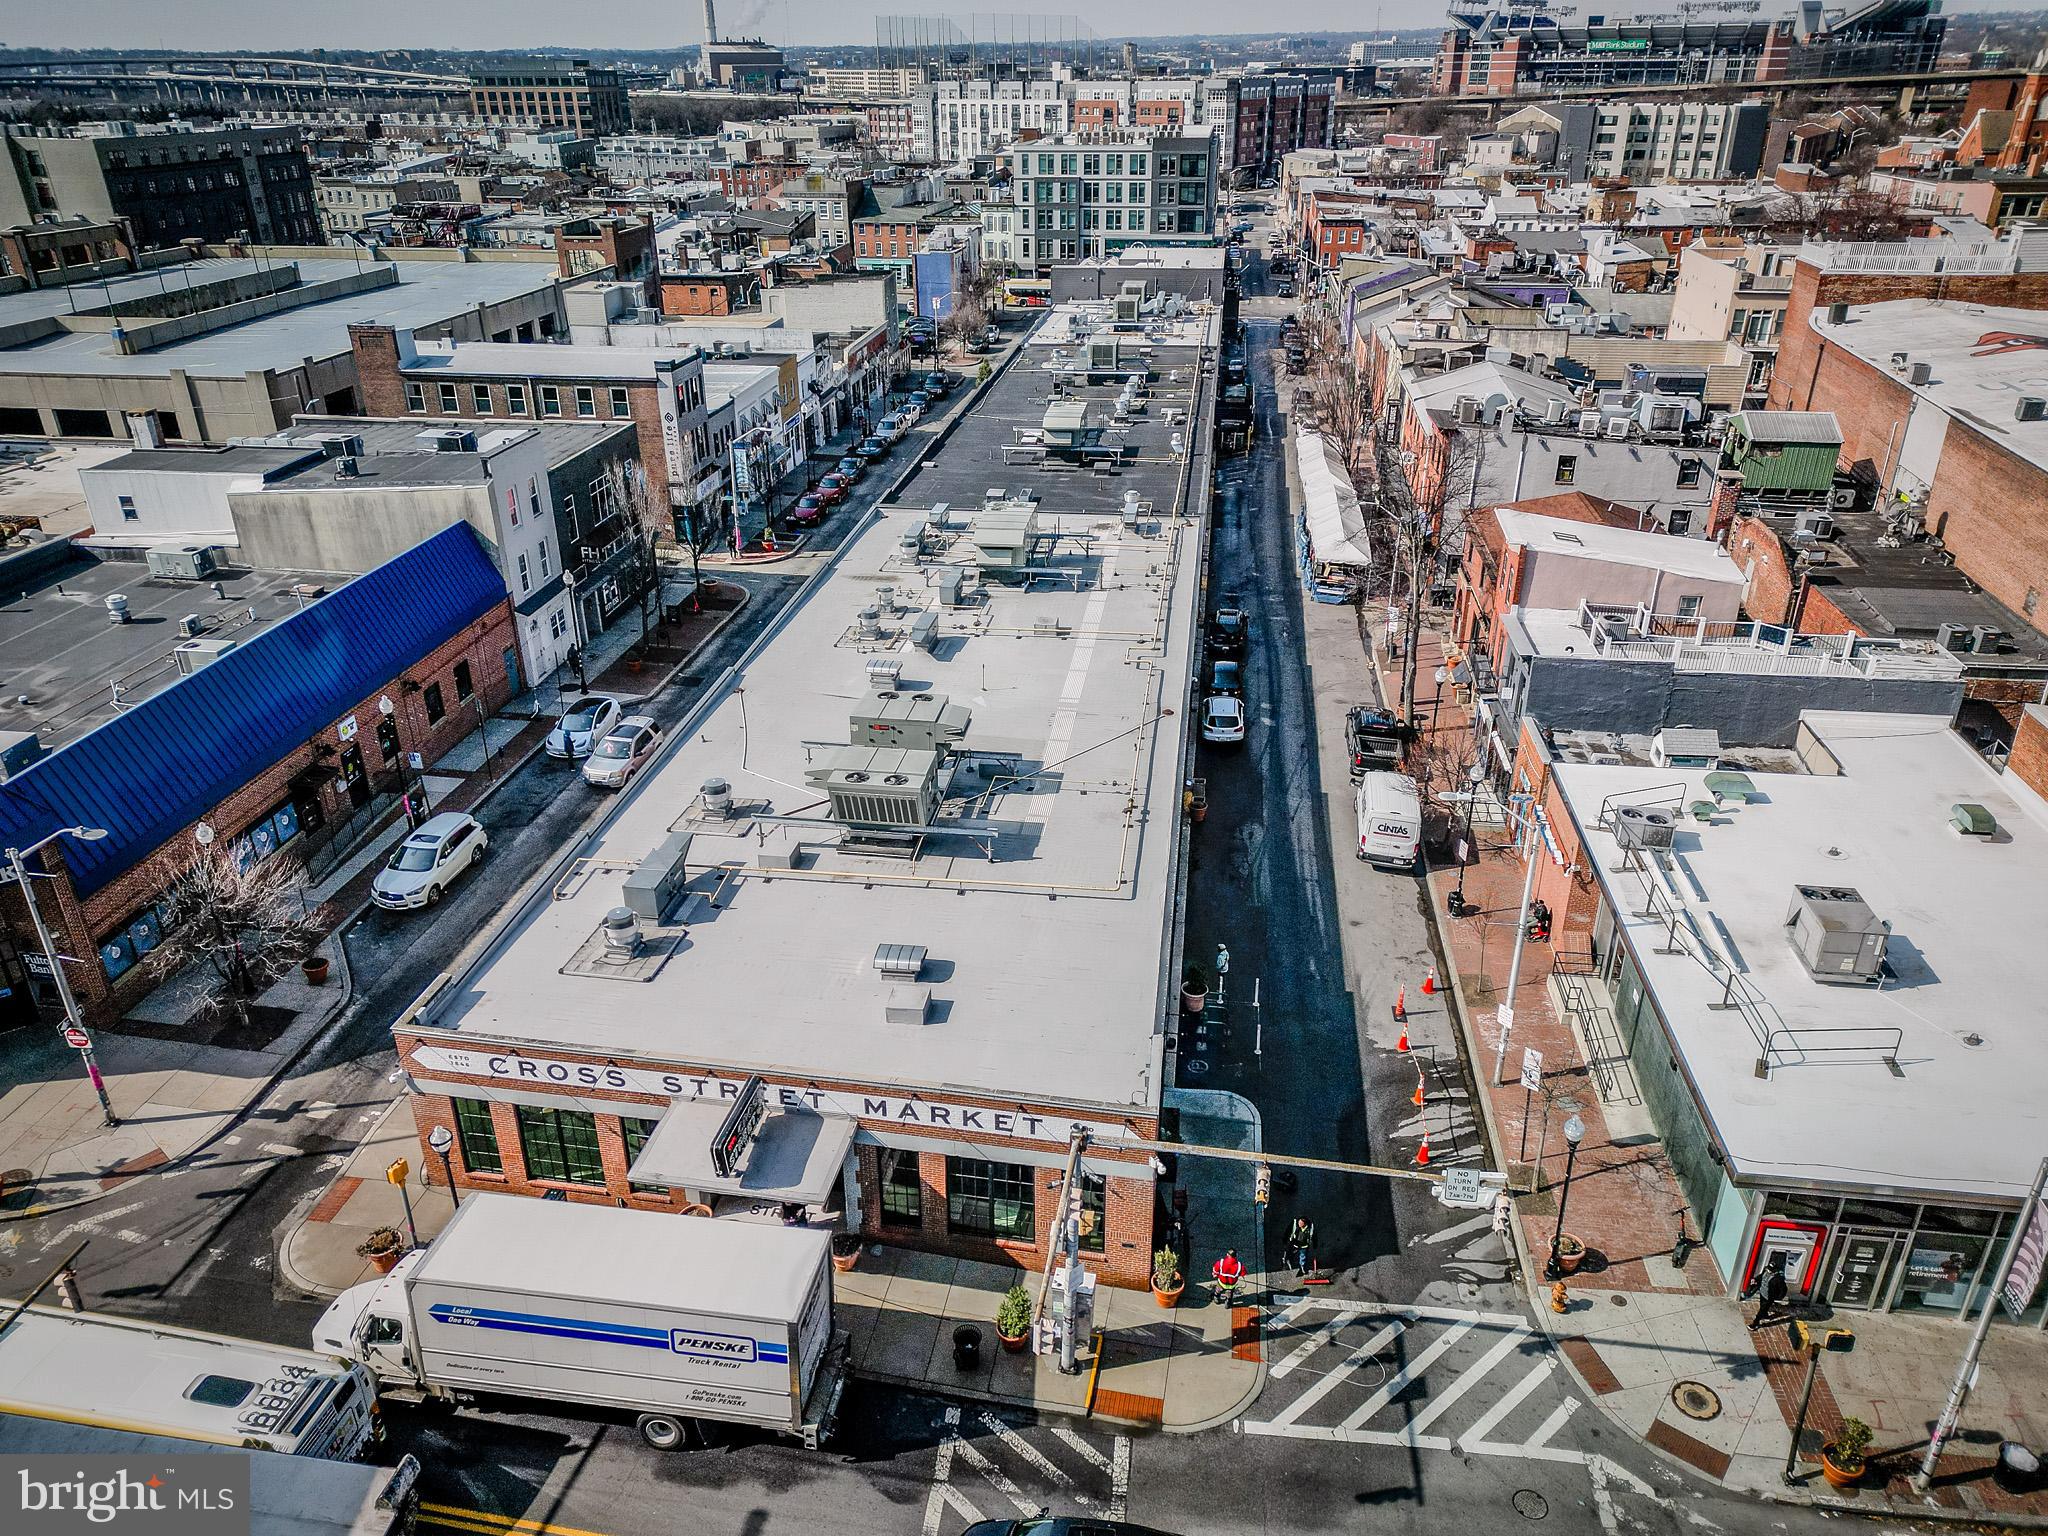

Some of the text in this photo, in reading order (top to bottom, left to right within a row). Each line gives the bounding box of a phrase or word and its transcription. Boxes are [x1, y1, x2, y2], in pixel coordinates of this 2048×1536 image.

[1621, 40, 1646, 49] Stadium
[23, 954, 50, 965] Fulto
[488, 1058, 626, 1088] CROSS
[864, 1098, 1043, 1135] MARKET
[750, 1204, 816, 1222] STRT
[1909, 1270, 1948, 1279] retirement
[452, 1306, 472, 1314] Local
[464, 1318, 480, 1327] Way
[678, 1338, 750, 1354] PENSKE
[688, 1357, 741, 1369] Truck Rental
[692, 1389, 742, 1400] GoPenske.com
[685, 1394, 748, 1407] 1-800-GO-PENSKE
